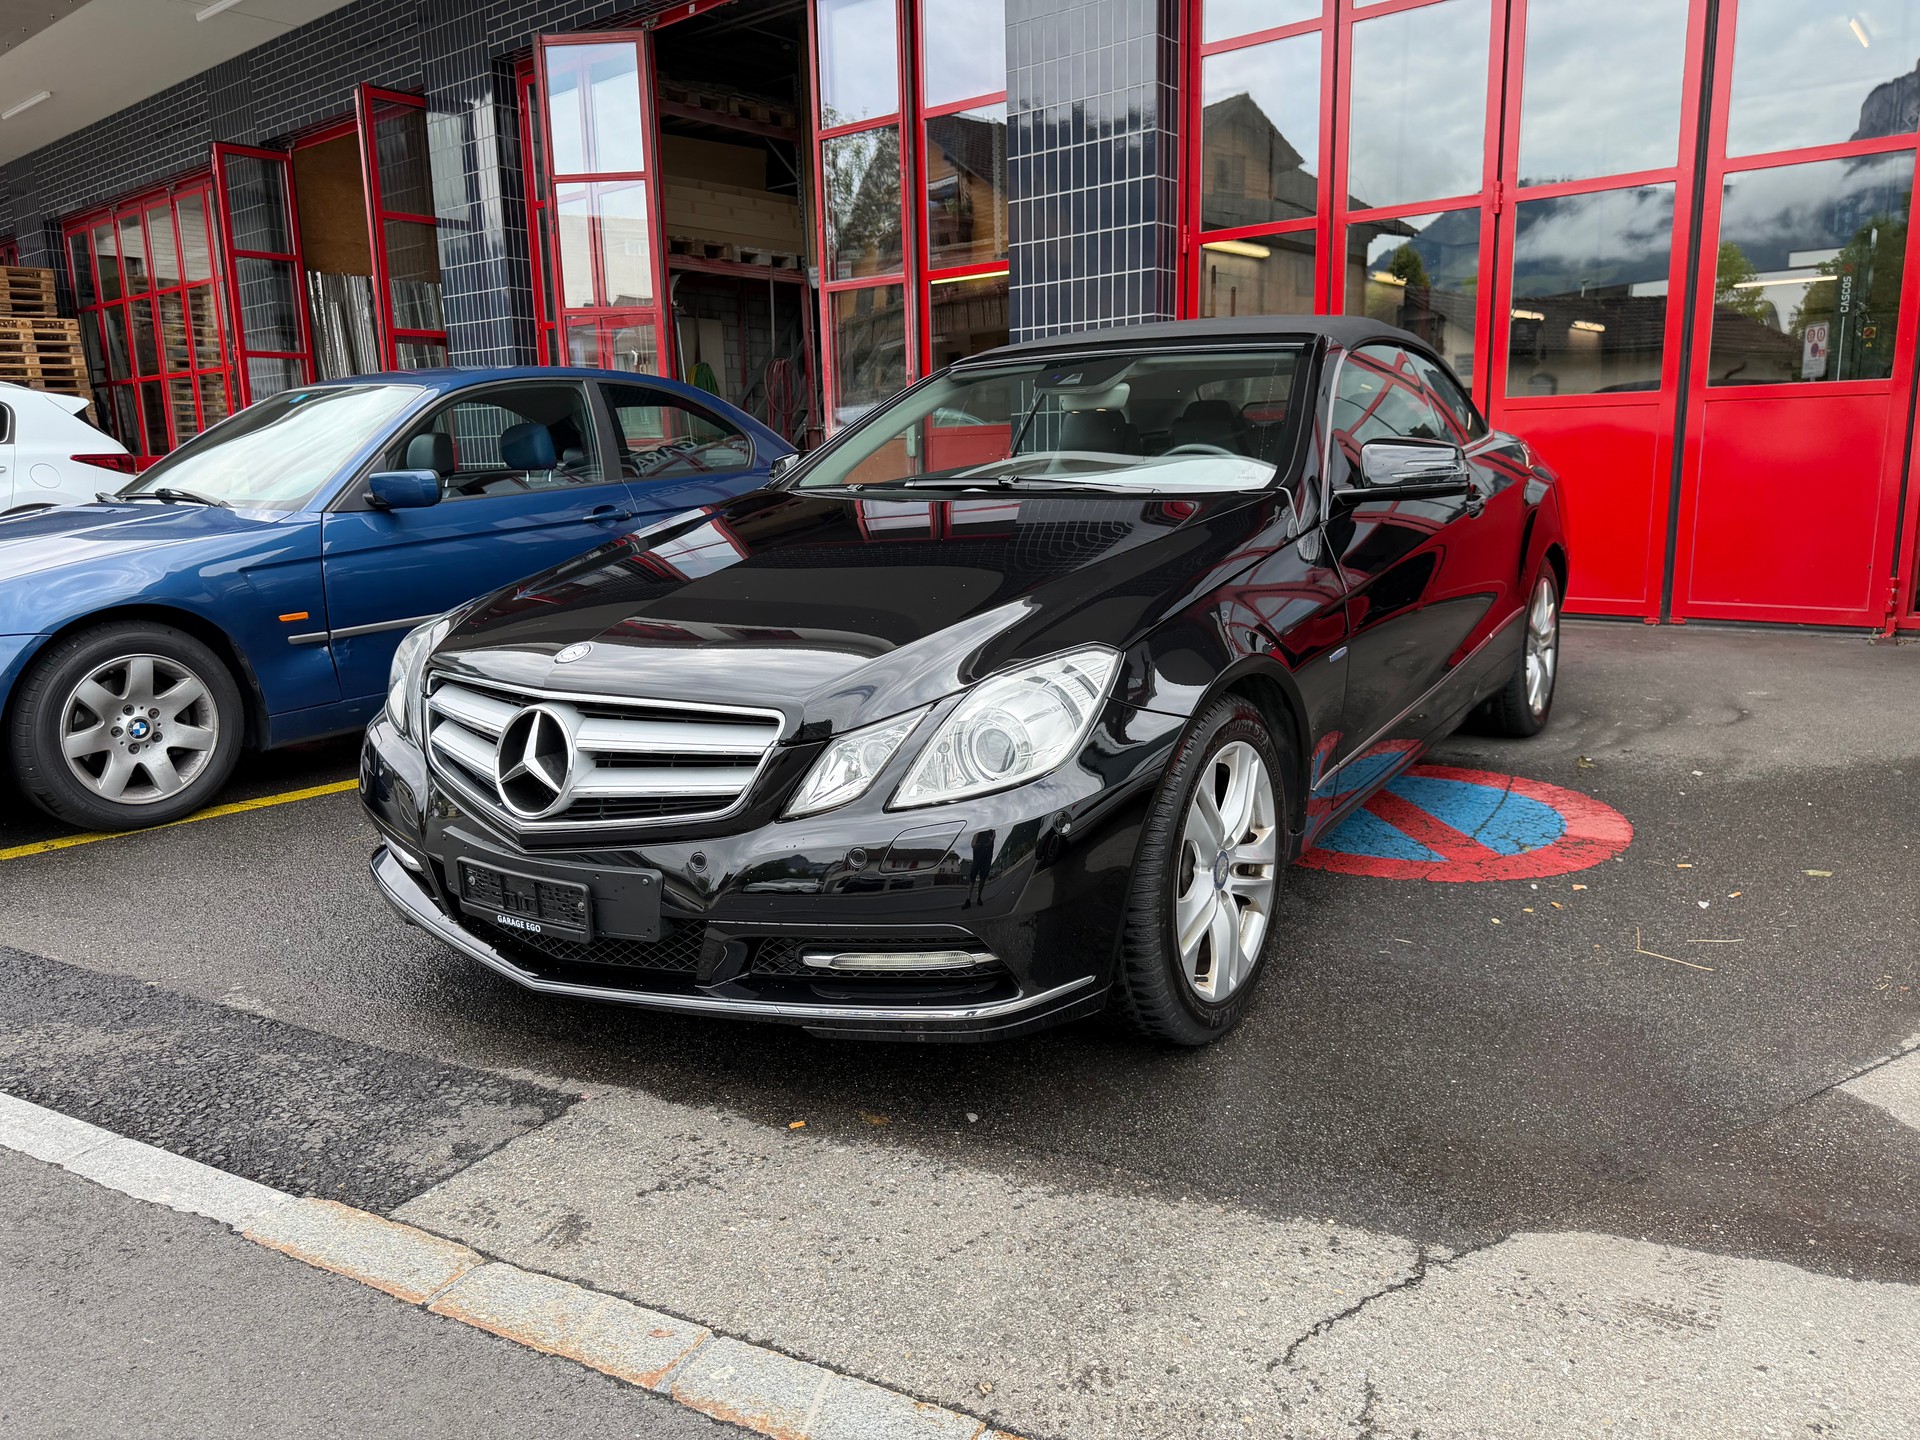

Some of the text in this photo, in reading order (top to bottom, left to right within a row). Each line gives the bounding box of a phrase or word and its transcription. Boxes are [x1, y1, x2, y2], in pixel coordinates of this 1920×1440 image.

[1840, 275, 1852, 313] CASCOS
[497, 914, 541, 933] GARAGE EGO
